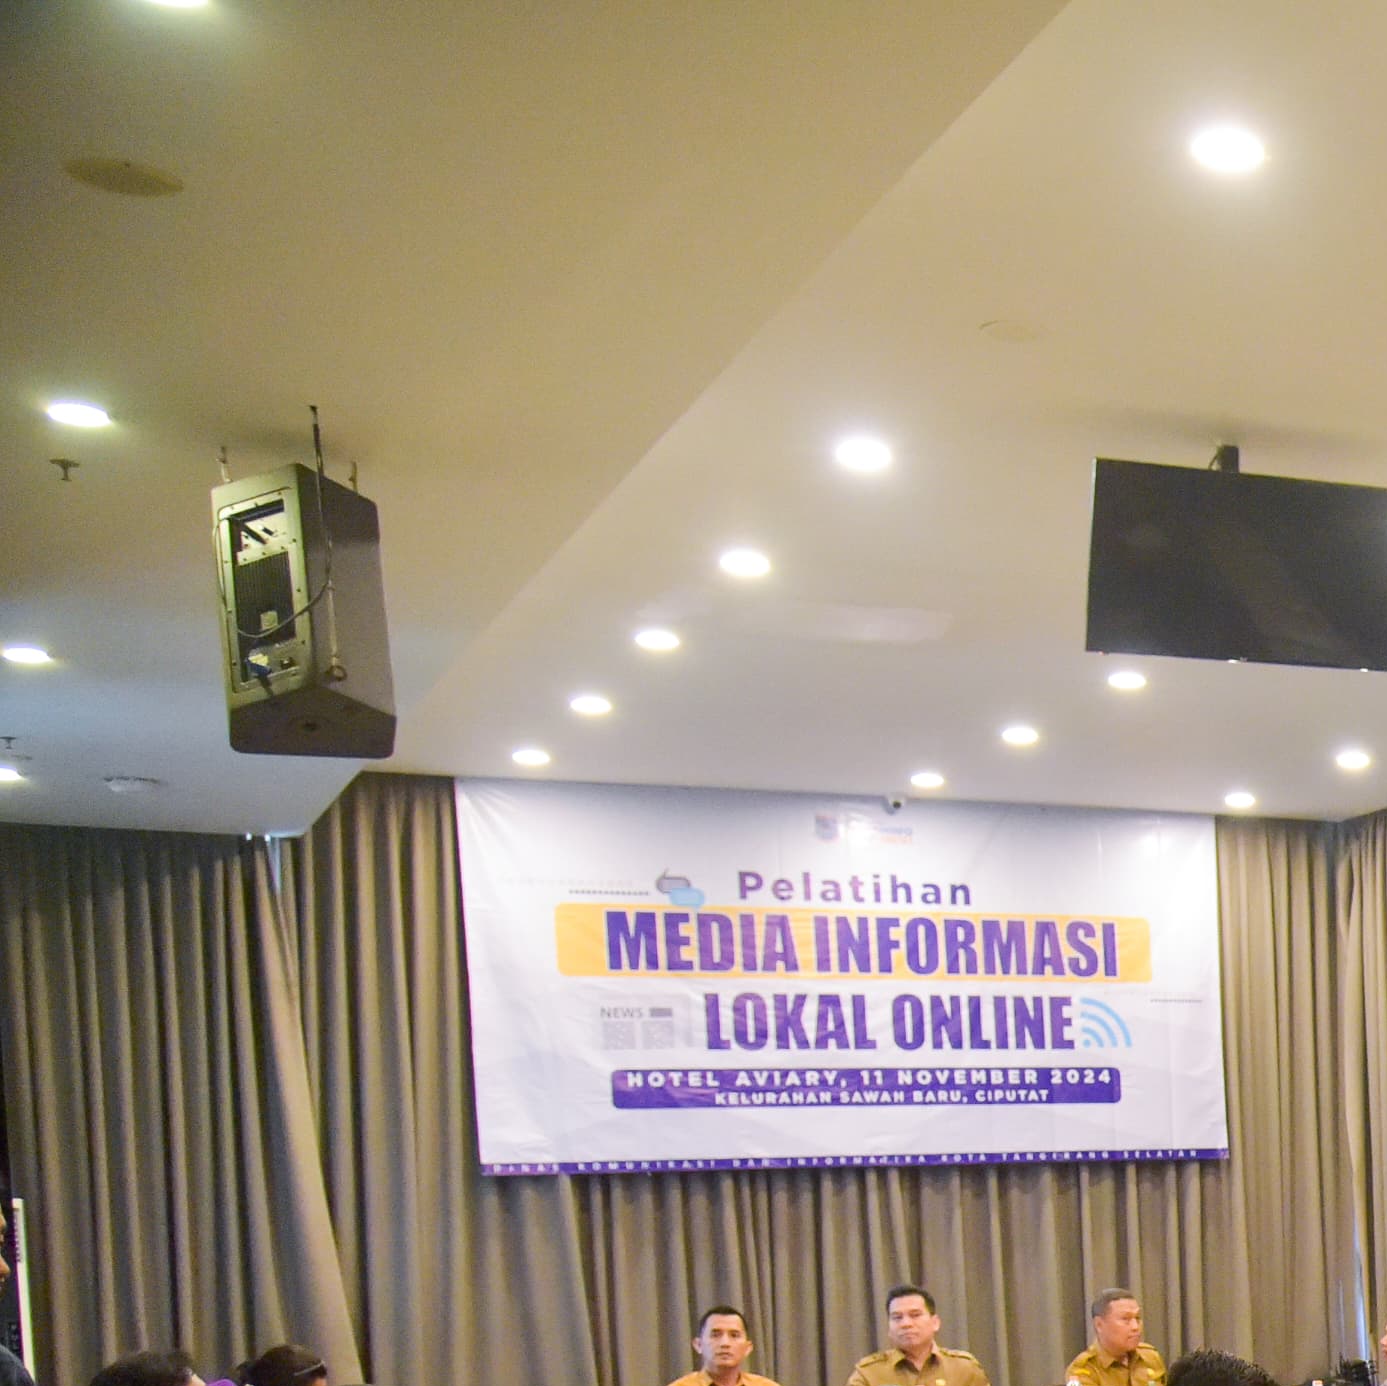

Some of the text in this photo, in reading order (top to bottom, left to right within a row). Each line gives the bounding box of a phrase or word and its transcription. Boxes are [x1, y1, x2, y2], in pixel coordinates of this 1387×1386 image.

[738, 871, 971, 905] Pelatihan
[605, 911, 1118, 977] MEDIA INFORMASI
[599, 1007, 643, 1019] NEWS
[704, 992, 1075, 1051] LOKAL ONLINE
[626, 1069, 1112, 1089] HOTEL AVIARY, 11 NOVEMBER 2024
[715, 1089, 1049, 1105] KELURAHAN SAWAH BARU, CIPUTAT
[493, 1163, 561, 1174] DINAS
[578, 1160, 717, 1172] KOMUNIKASI
[732, 1158, 770, 1168] DAN
[940, 1153, 987, 1163] KOTA
[1001, 1151, 1110, 1162] TANGERANG
[1123, 1149, 1198, 1160] SELATAN
